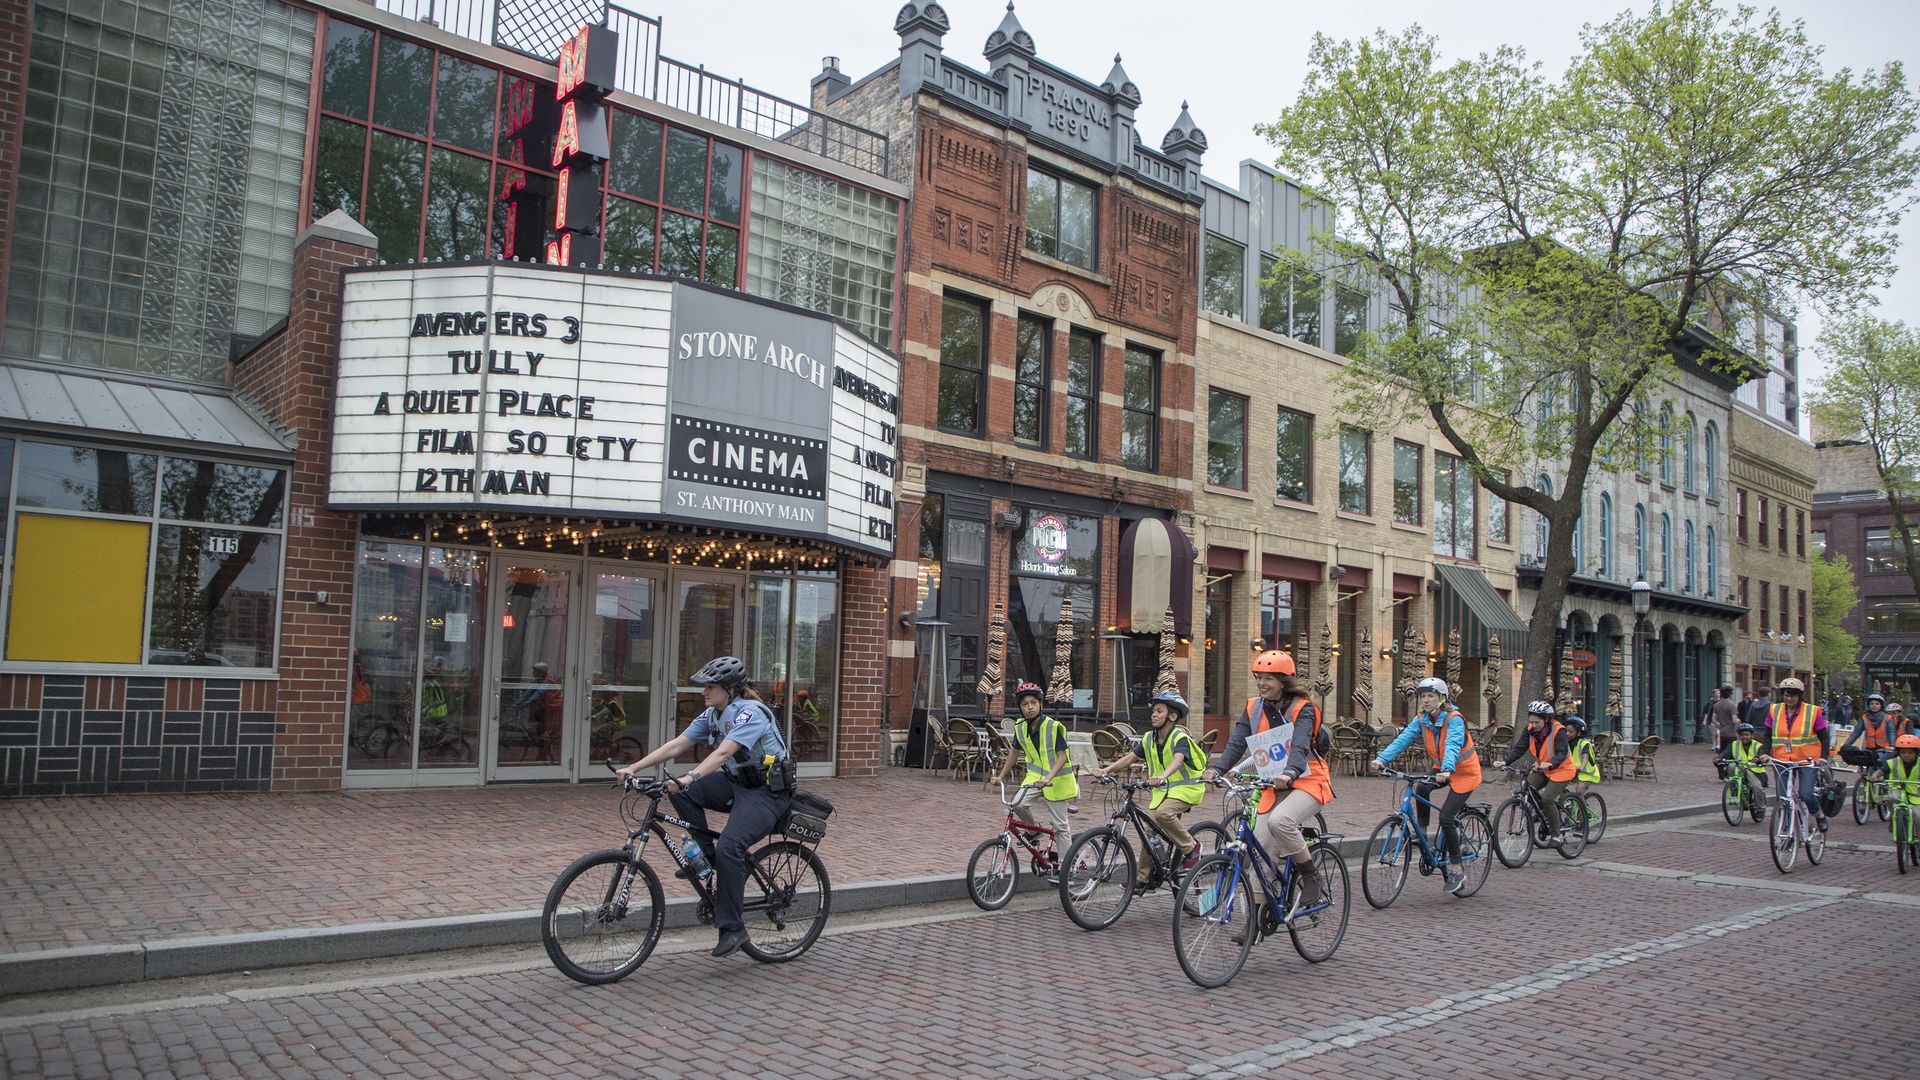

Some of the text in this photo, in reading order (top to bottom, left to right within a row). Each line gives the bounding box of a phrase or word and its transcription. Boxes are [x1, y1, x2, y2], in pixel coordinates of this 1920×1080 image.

[1028, 75, 1110, 128] PRACNA
[1047, 108, 1090, 141] 1890
[410, 311, 580, 344] AVENGERS 3
[448, 350, 544, 376] TULLY
[679, 331, 827, 389] STONE ARCH
[374, 389, 595, 420] A QUIET PLACE
[417, 428, 475, 455] FILM
[853, 444, 862, 466] A
[688, 437, 809, 481] CINEMA
[415, 467, 551, 496] 12TH MAN
[677, 491, 815, 523] ST. ANTHONY MAIN
[211, 537, 237, 553] 115
[1021, 560, 1076, 575] Historic Dining Saloon
[664, 815, 690, 828] POLICE
